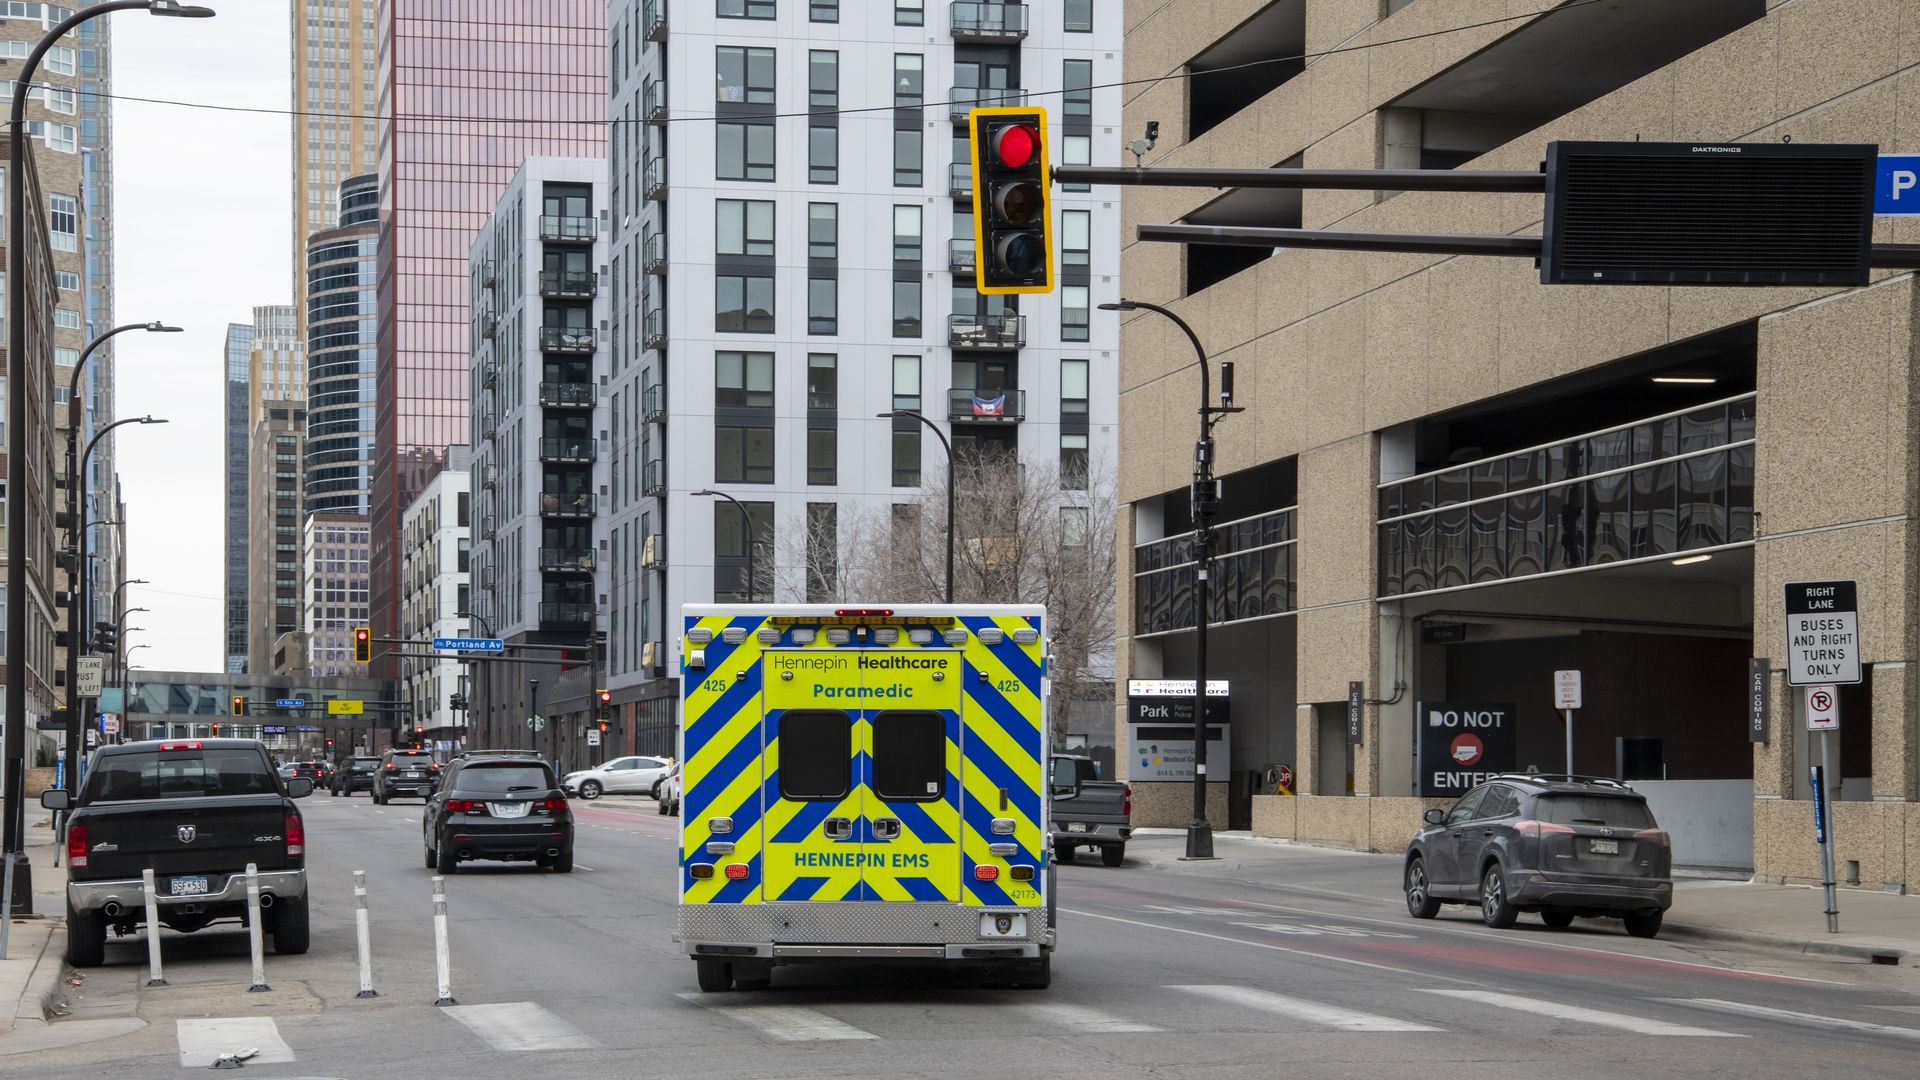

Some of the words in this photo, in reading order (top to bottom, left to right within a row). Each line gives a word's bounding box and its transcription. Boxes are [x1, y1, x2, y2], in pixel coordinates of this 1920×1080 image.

[1806, 587, 1836, 597] RIGHT
[1808, 599, 1835, 609] LANE
[1801, 619, 1844, 632] BUSES
[445, 640, 486, 649] Portland
[488, 641, 502, 649] Av
[1793, 635, 1815, 647] AND
[1821, 633, 1853, 646] RIGHT
[1802, 648, 1846, 661] TURNS
[774, 655, 848, 673] Hennepin
[858, 655, 948, 670] Healthcare
[1807, 663, 1841, 676] ONLY
[703, 678, 727, 693] 425
[998, 679, 1020, 693] 425
[1159, 681, 1216, 690] Hennein
[1754, 673, 1762, 691] CAR
[813, 683, 914, 698] Paramedic
[1140, 704, 1169, 718] Park
[1753, 694, 1763, 731] COMING
[1429, 710, 1459, 728] DO
[1463, 711, 1505, 728] NOT
[794, 852, 885, 868] HENNEPIN
[892, 853, 930, 868] EMS
[172, 881, 187, 892] GSF
[1010, 890, 1036, 899] 42173
